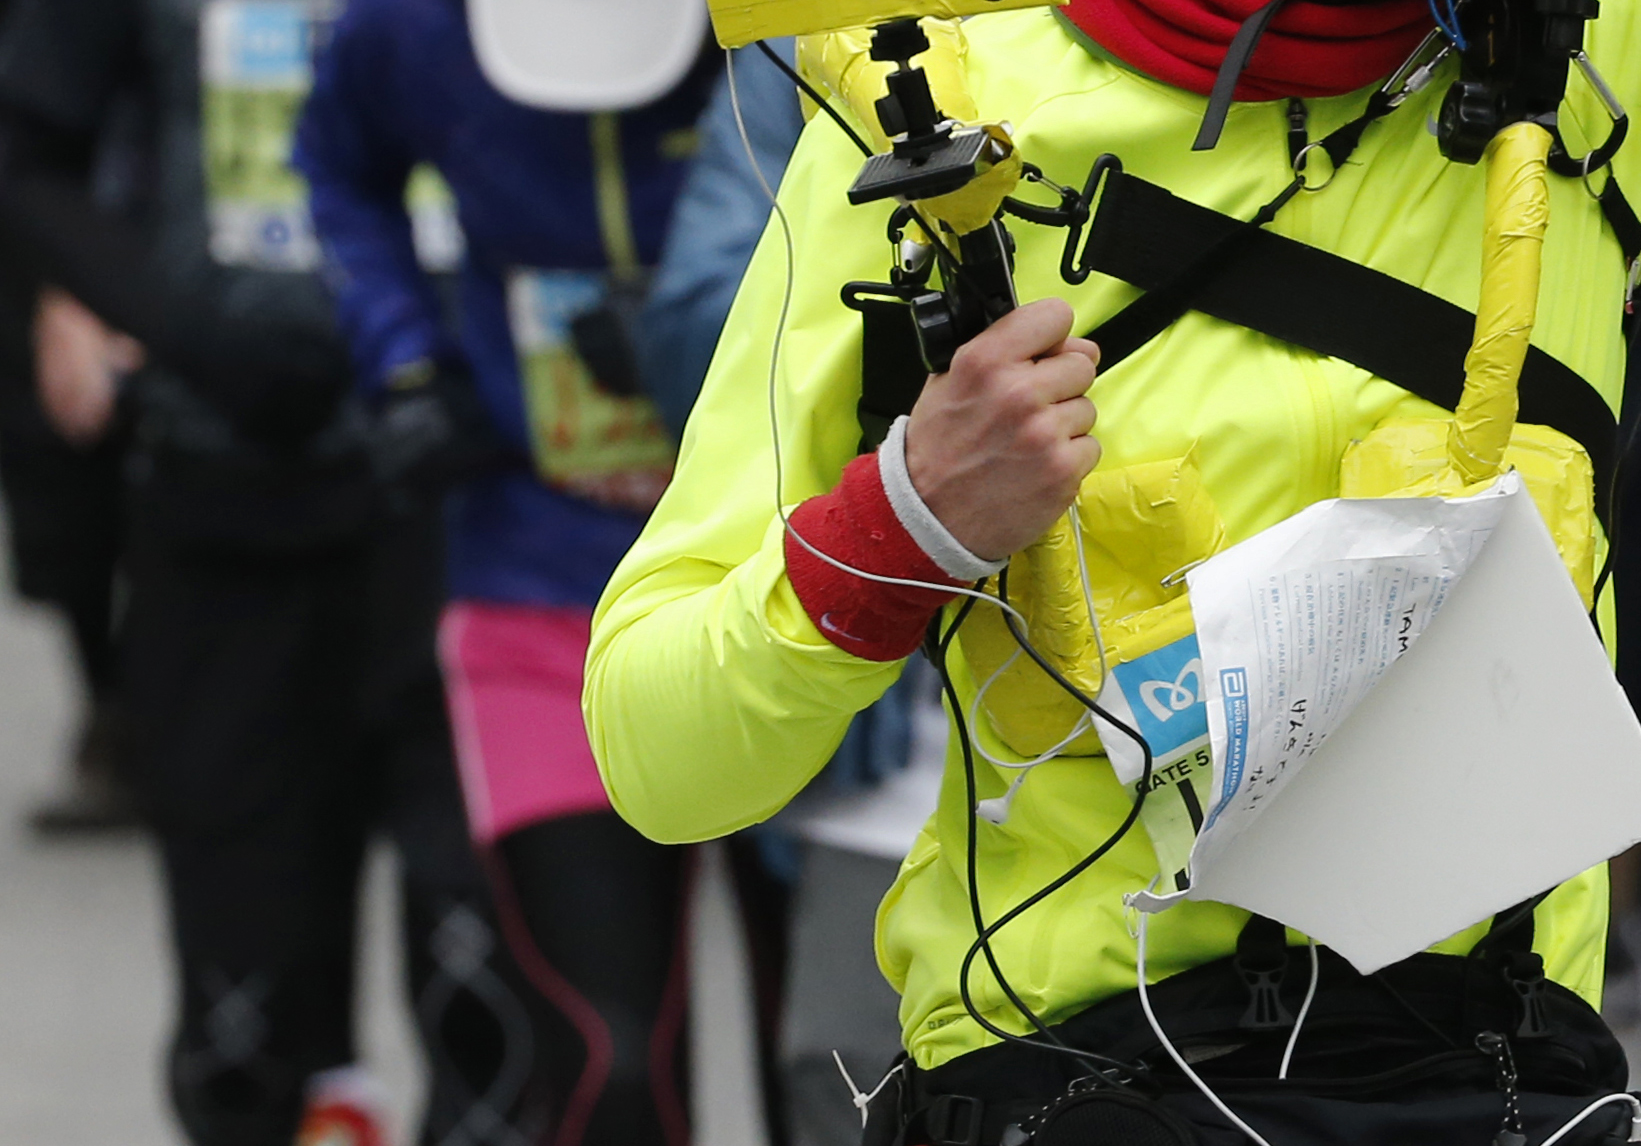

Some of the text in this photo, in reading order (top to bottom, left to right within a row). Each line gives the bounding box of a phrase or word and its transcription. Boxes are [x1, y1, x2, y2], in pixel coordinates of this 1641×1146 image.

[1394, 602, 1417, 662] TAM
[1233, 699, 1242, 735] WORLD
[1195, 750, 1210, 767] 5
